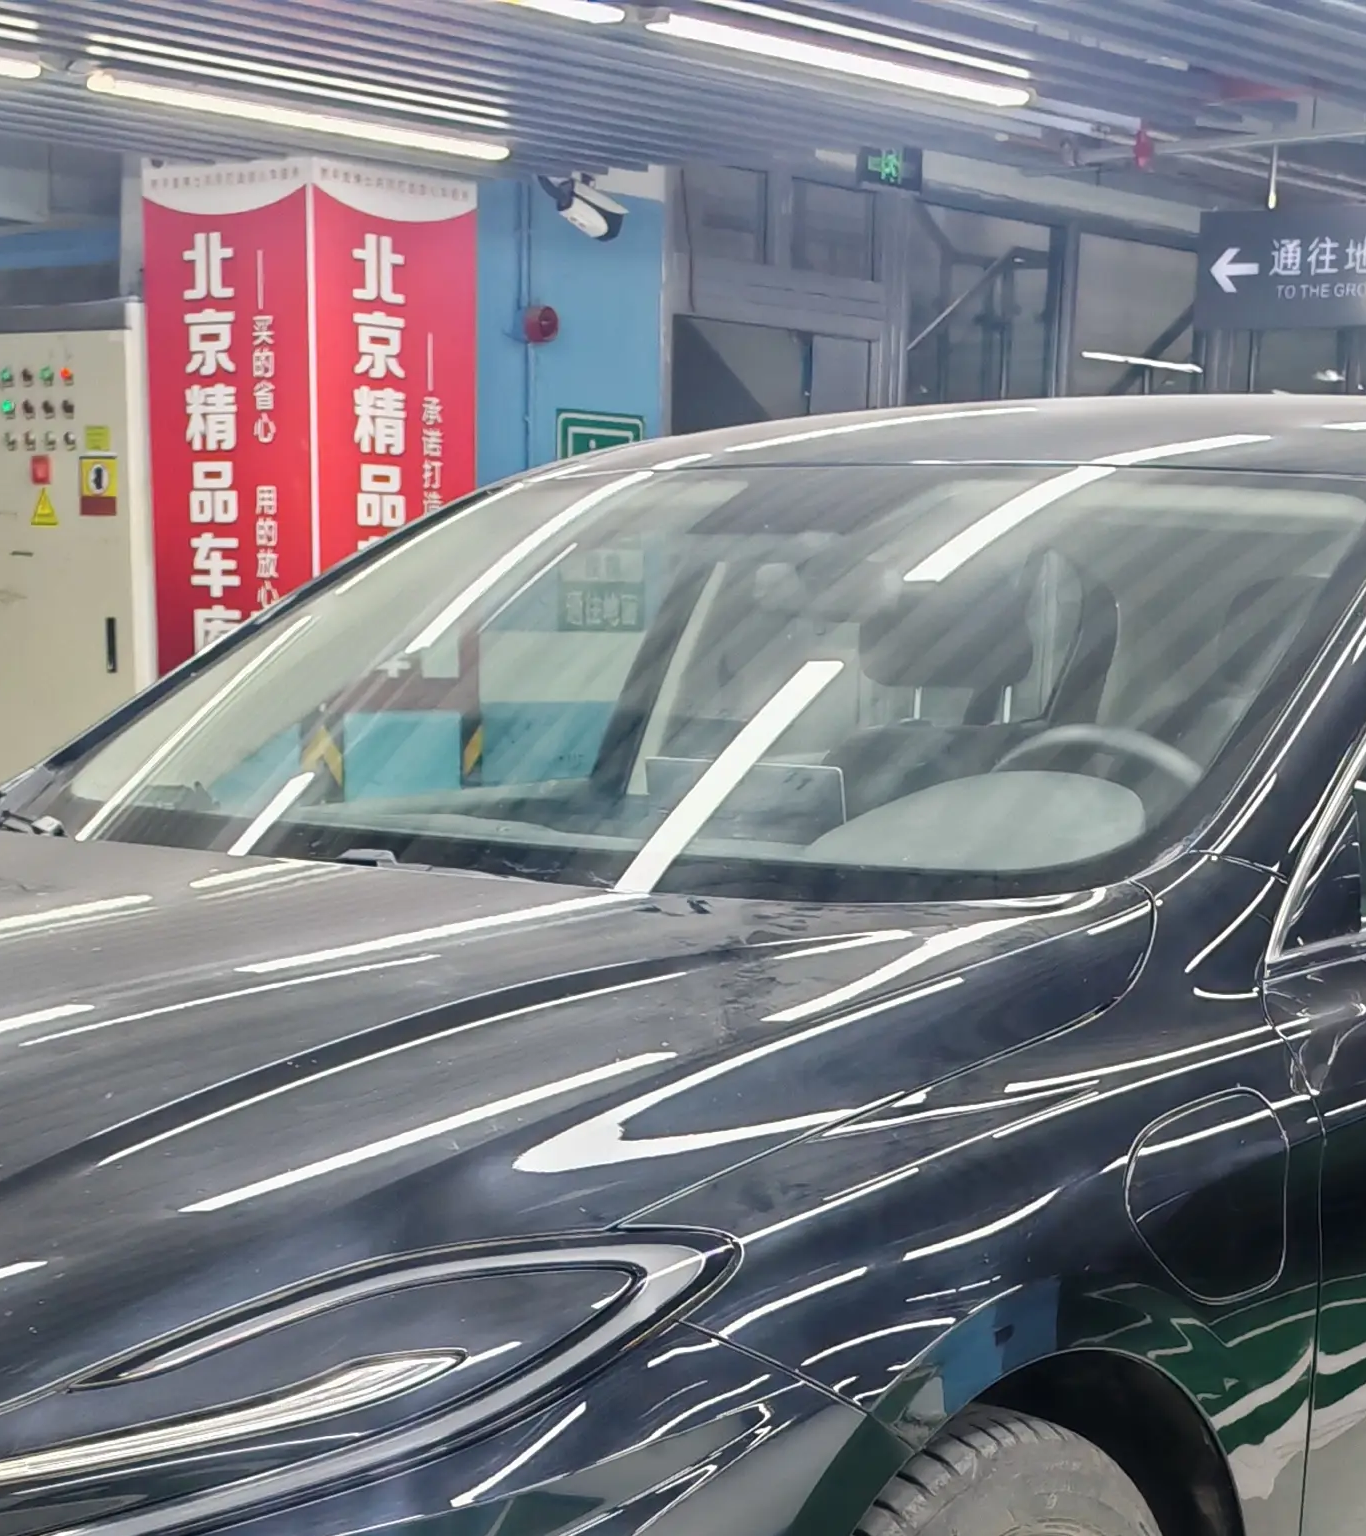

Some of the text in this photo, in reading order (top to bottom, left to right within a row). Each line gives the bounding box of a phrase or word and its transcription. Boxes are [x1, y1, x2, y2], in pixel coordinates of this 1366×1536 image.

[1276, 284, 1296, 300] TO
[1300, 284, 1329, 299] THE
[351, 233, 407, 550] 北京精品
